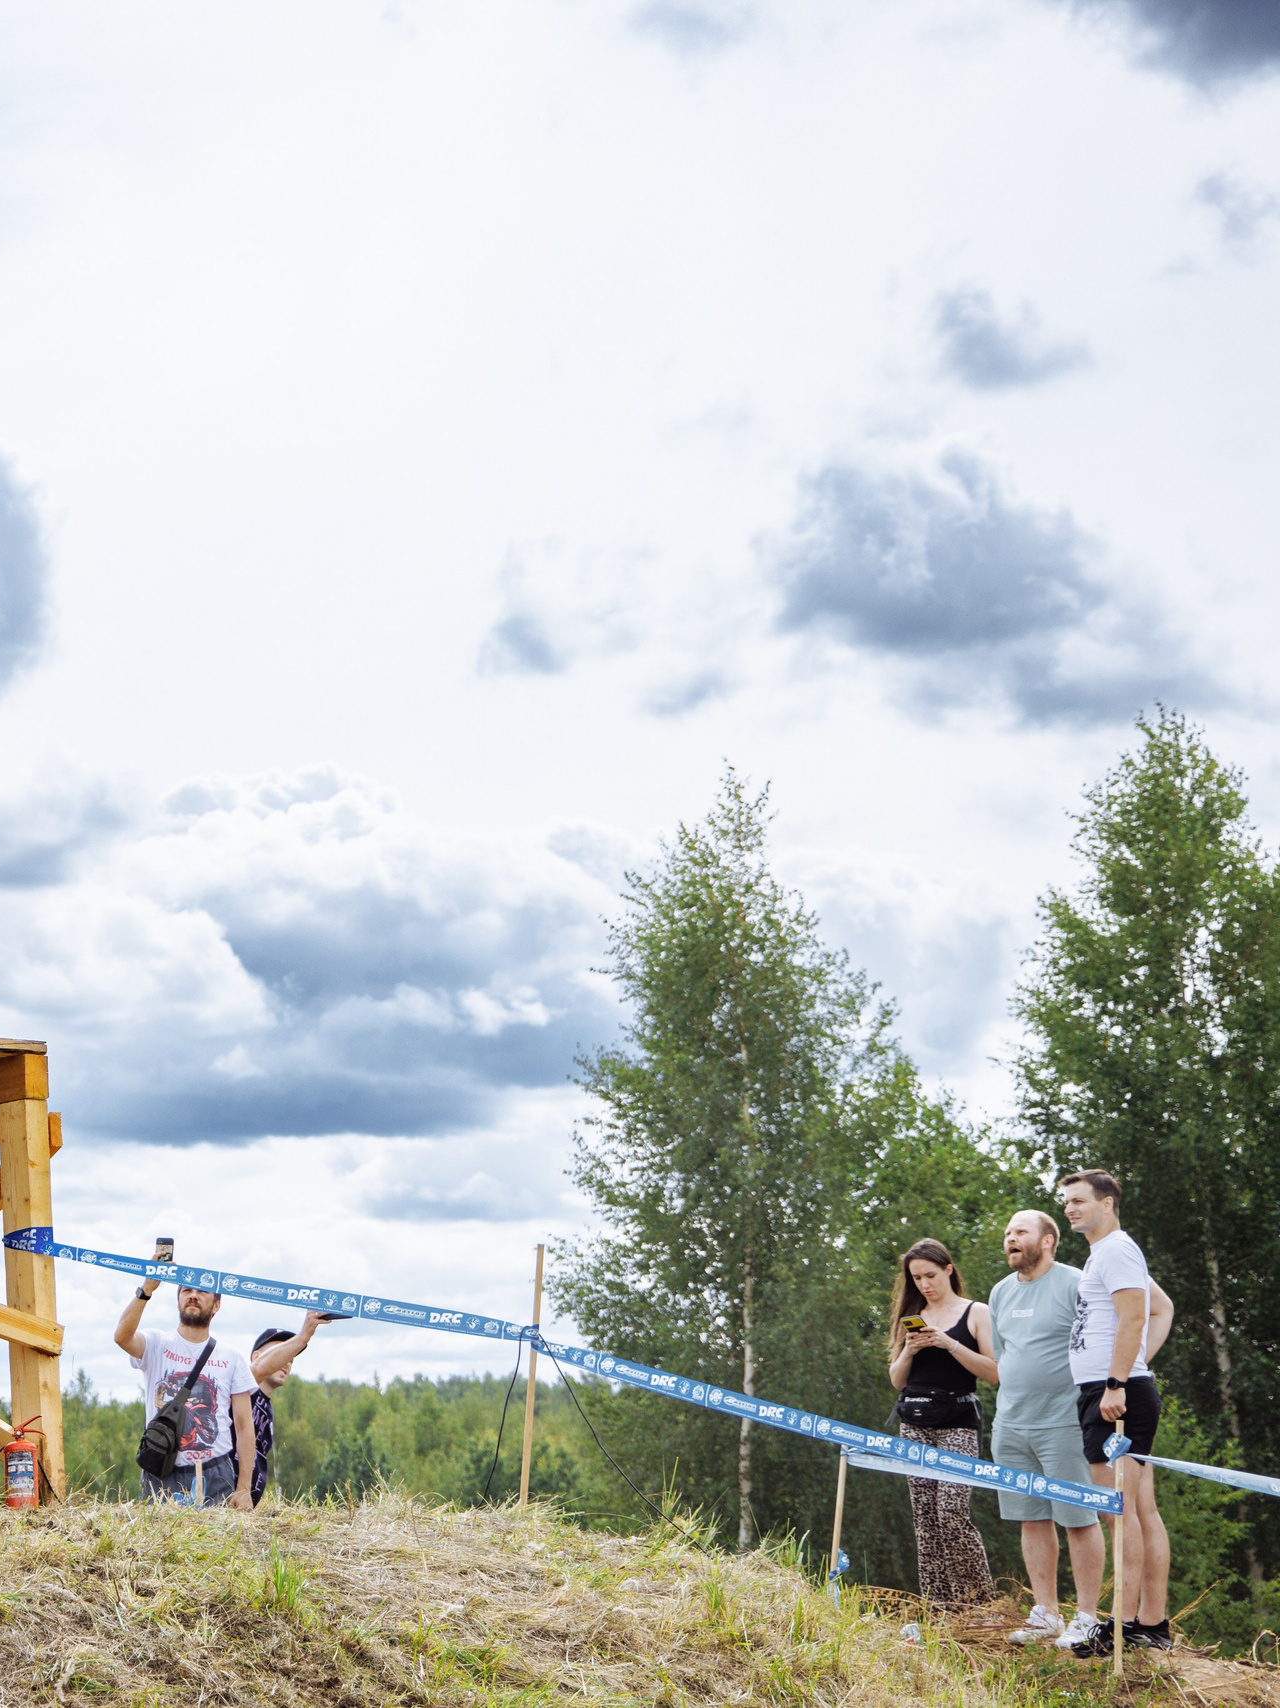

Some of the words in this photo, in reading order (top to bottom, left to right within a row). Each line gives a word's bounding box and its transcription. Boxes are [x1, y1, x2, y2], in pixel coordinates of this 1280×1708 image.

[145, 1265, 178, 1276] DRC
[286, 1288, 320, 1300] DRC
[429, 1312, 463, 1323] DRC
[195, 1358, 229, 1369] LLY
[650, 1374, 677, 1387] DRC
[758, 1405, 785, 1418] DRC
[866, 1435, 893, 1448] DRC
[186, 1449, 212, 1461] 2024
[974, 1464, 1001, 1476] DRC
